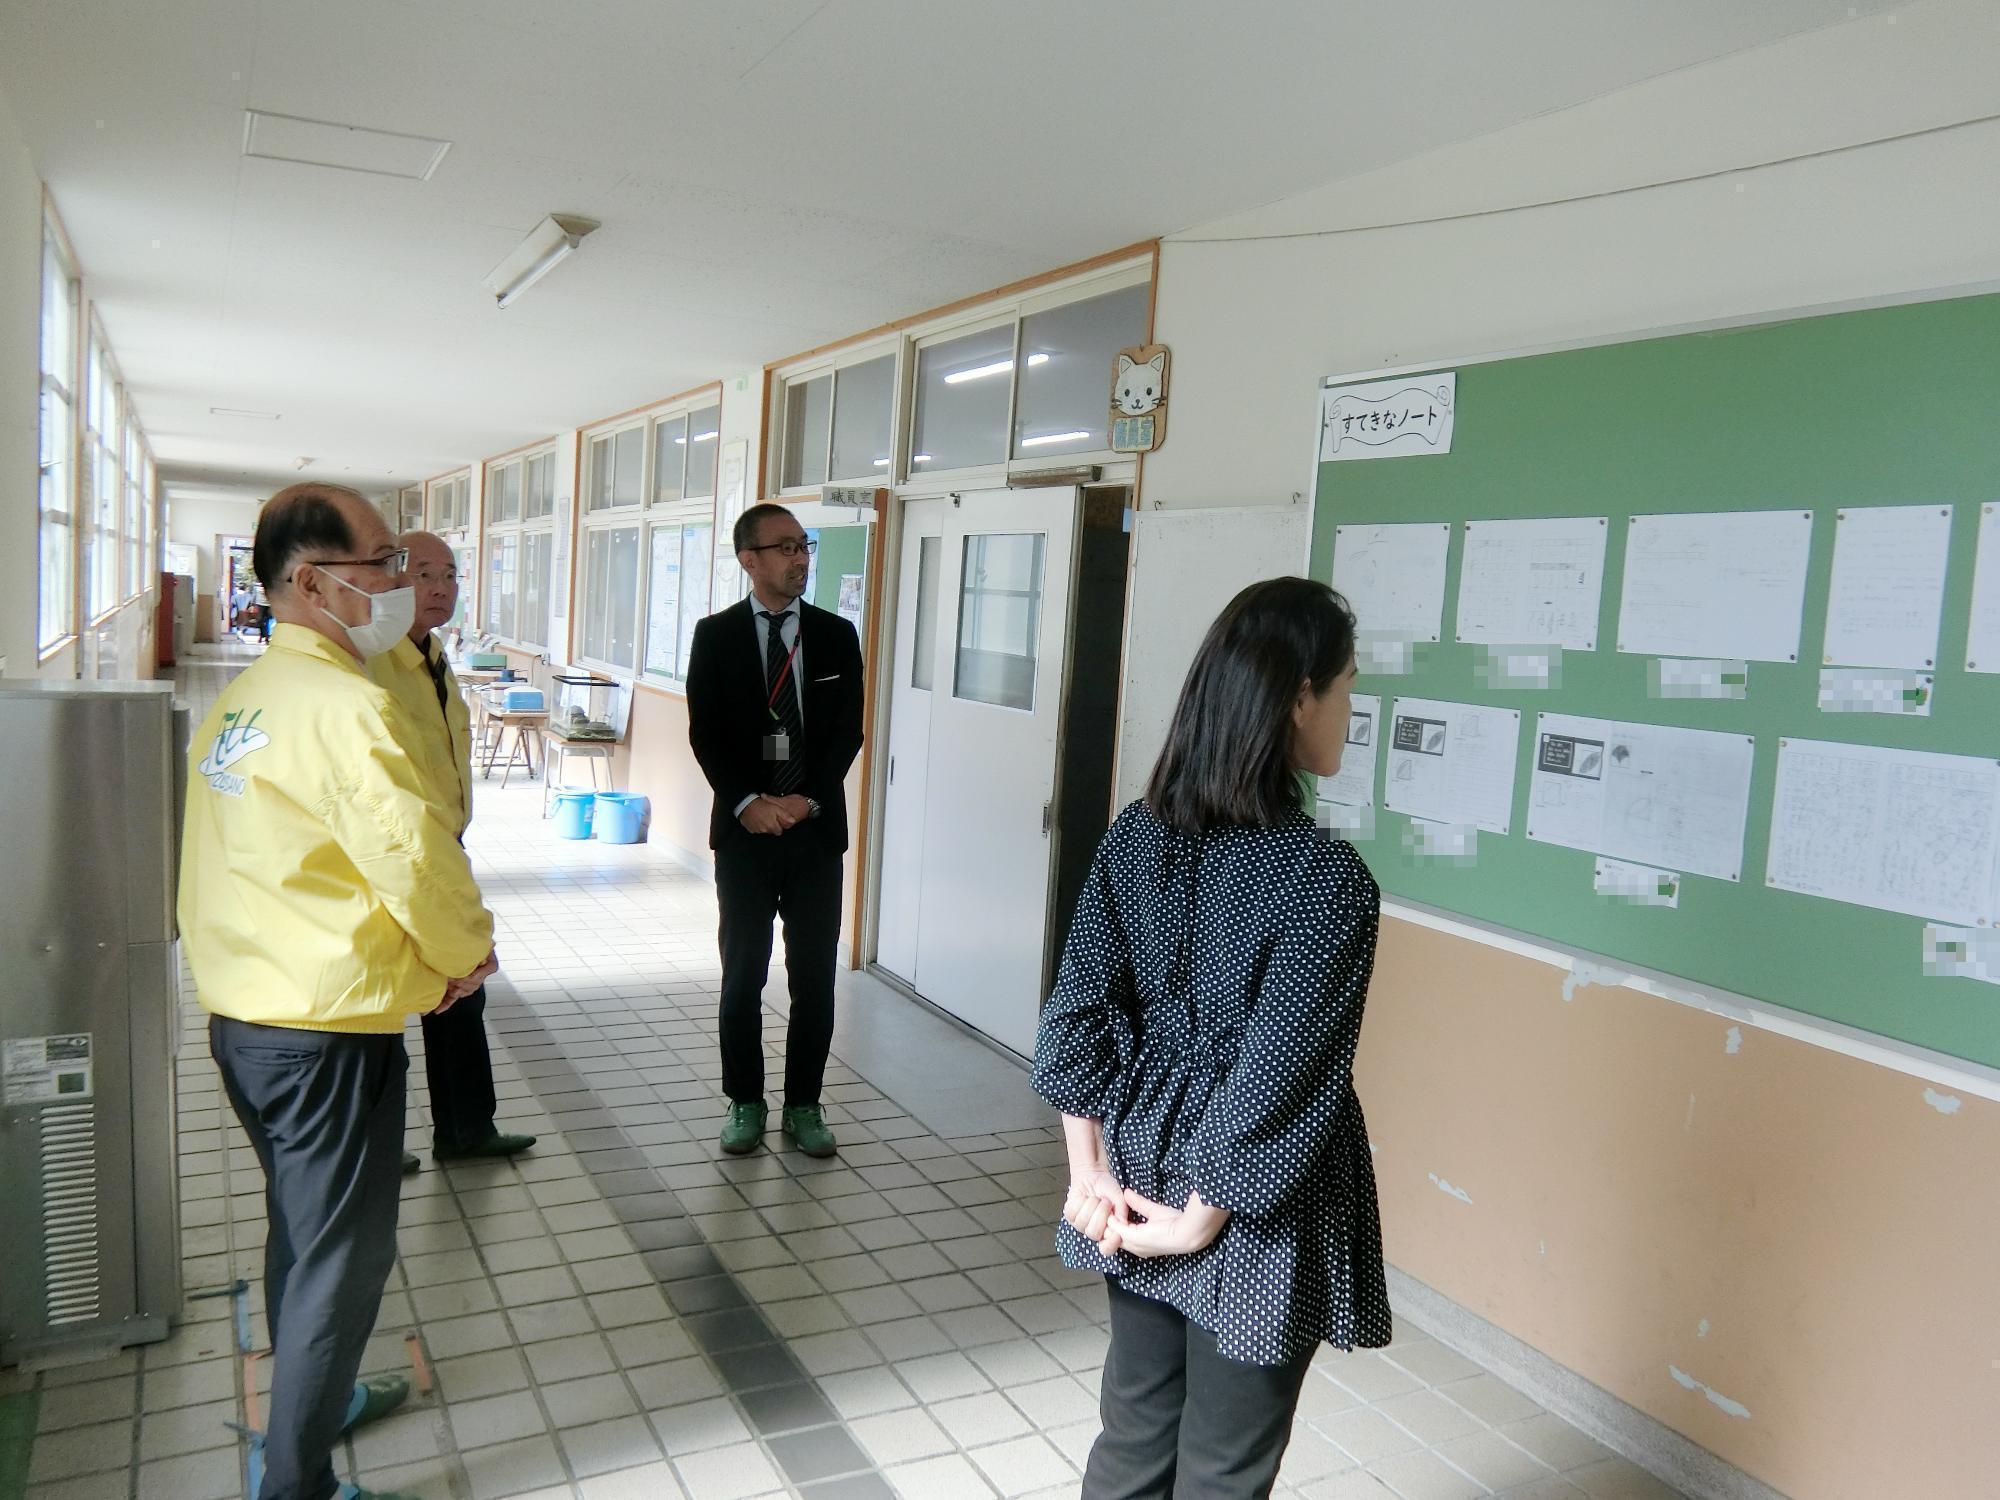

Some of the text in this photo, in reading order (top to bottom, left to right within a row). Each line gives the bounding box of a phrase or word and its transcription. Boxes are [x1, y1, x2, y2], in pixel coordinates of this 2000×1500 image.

[1342, 405, 1437, 434] すてきなノート
[831, 488, 872, 506] 職員室
